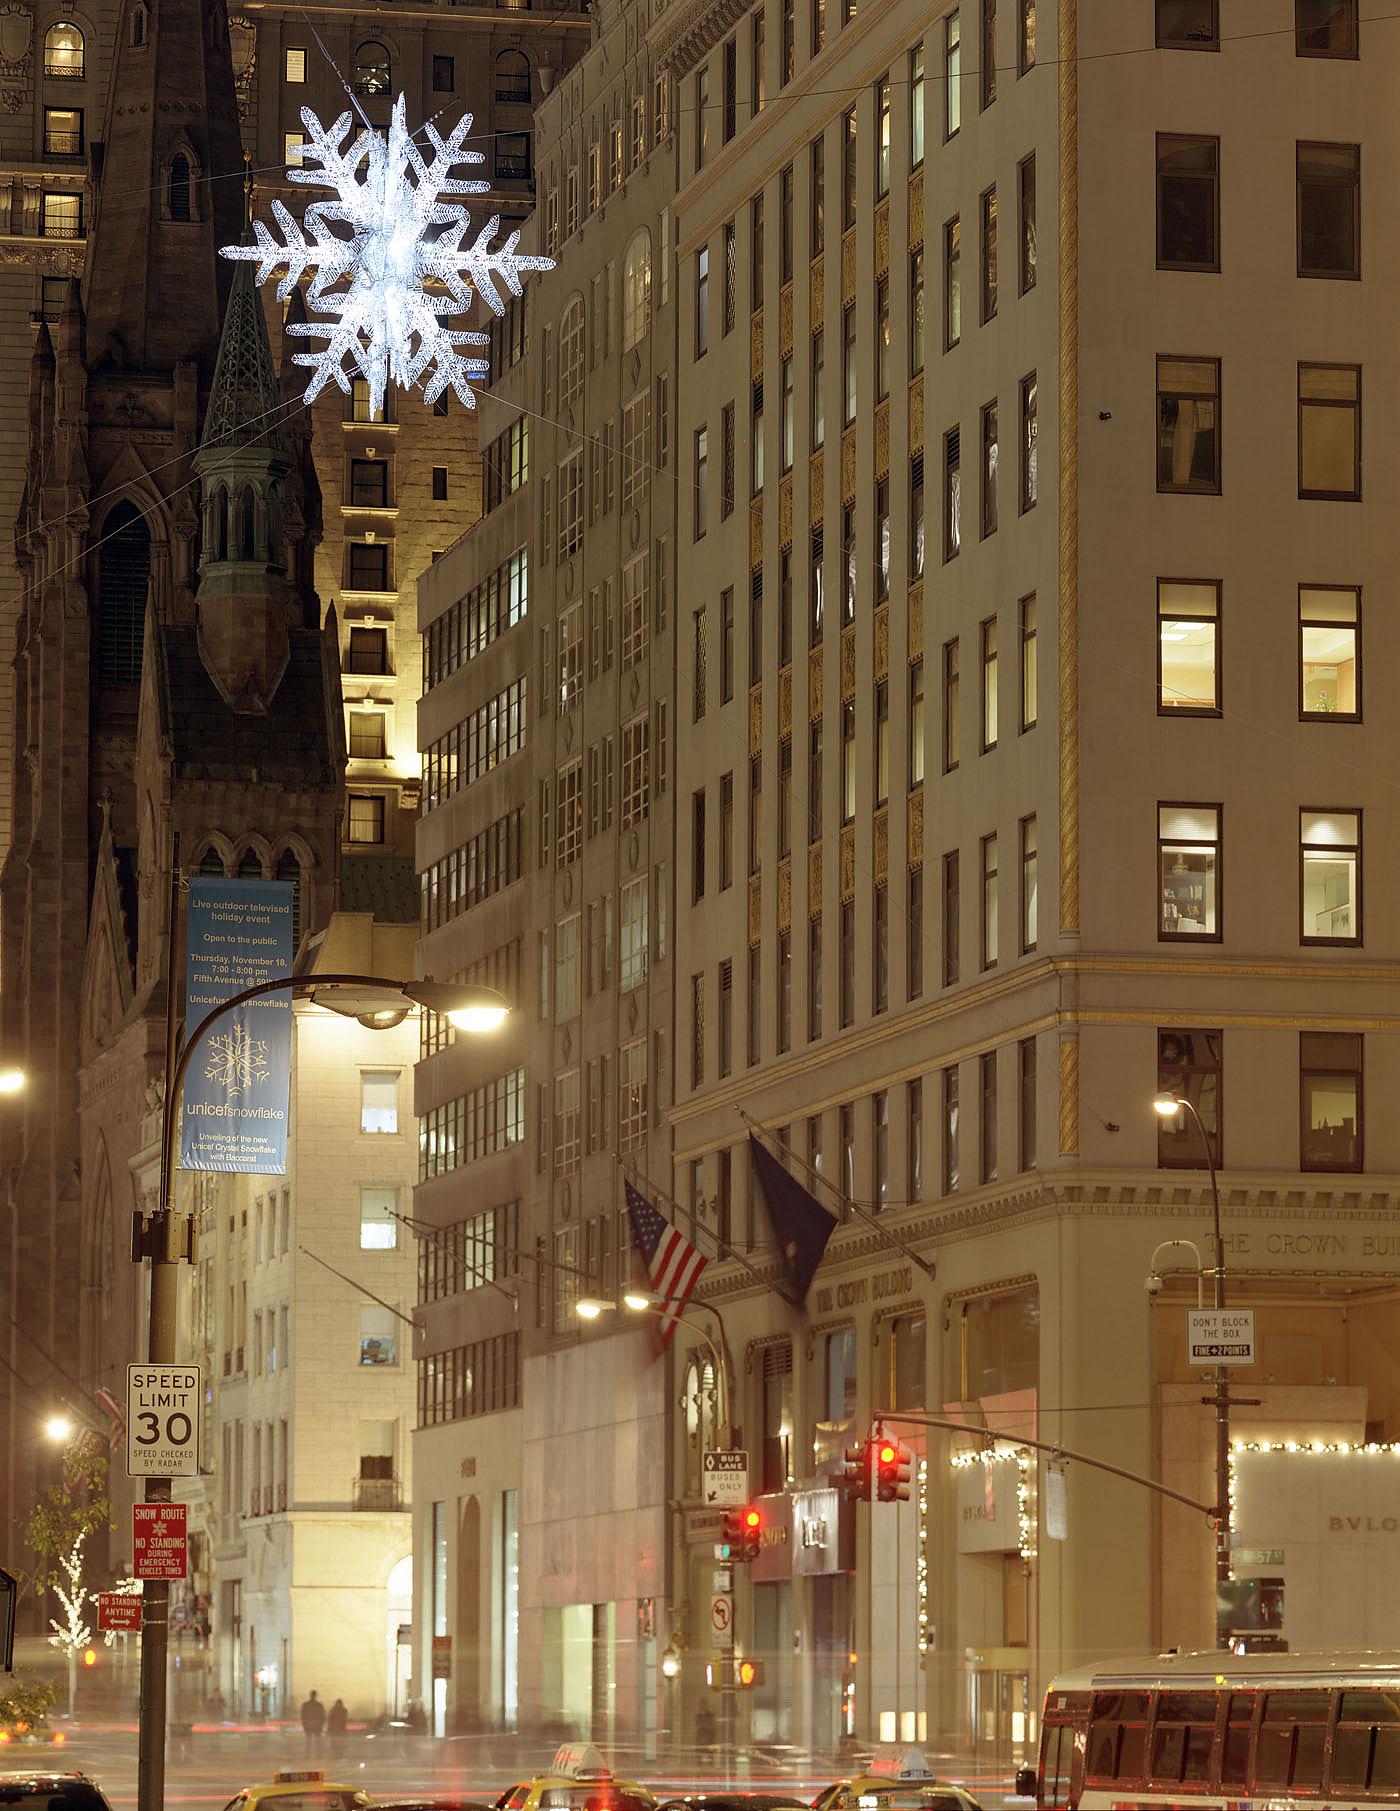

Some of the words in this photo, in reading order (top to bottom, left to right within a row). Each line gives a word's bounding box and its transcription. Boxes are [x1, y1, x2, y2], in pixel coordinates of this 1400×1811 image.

[192, 899, 211, 909] Live
[213, 902, 248, 911] outdoor
[250, 904, 290, 913] televised
[211, 912, 243, 924] holiday
[245, 915, 270, 924] event
[203, 933, 225, 943] Open
[252, 937, 278, 945] public
[190, 953, 231, 964] Thursday,
[232, 956, 274, 965] November
[211, 965, 229, 973] 7:00
[193, 974, 212, 982] Fifth
[214, 976, 244, 985] Avenue
[246, 977, 255, 987] @
[187, 1102, 284, 1119] unicefsnowflake
[199, 1133, 231, 1142] Unveiling
[191, 1142, 214, 1151] Unicef
[215, 1144, 239, 1153] Crystal
[240, 1145, 277, 1154] Snowflake
[210, 1153, 225, 1161] with
[226, 1154, 257, 1163] Baccarat
[1266, 1234, 1348, 1255] CROWN
[1222, 1317, 1249, 1328] BLOCK
[1203, 1329, 1218, 1338] THE
[1223, 1329, 1240, 1339] BOX
[133, 1375, 195, 1388] SPEED
[140, 1393, 188, 1407] LIMIT
[135, 1411, 192, 1446] 30
[133, 1449, 157, 1458] SPEED
[160, 1450, 193, 1459] CHECKED
[144, 1459, 154, 1467] BY
[158, 1459, 182, 1468] RADAR
[710, 1473, 740, 1481] BUSES
[135, 1508, 156, 1520] SNOW
[160, 1508, 185, 1520] ROUTE
[135, 1538, 146, 1549] NO
[150, 1538, 185, 1549] STANDING
[147, 1549, 173, 1558] DURING
[1256, 1550, 1271, 1564] 57
[139, 1558, 180, 1567] EMERGENCY
[138, 1567, 162, 1575] VEHICLES
[165, 1567, 182, 1575] TOWED
[100, 1597, 109, 1605] NO
[111, 1597, 141, 1606] STANDING
[105, 1608, 136, 1617] ANYTIME
